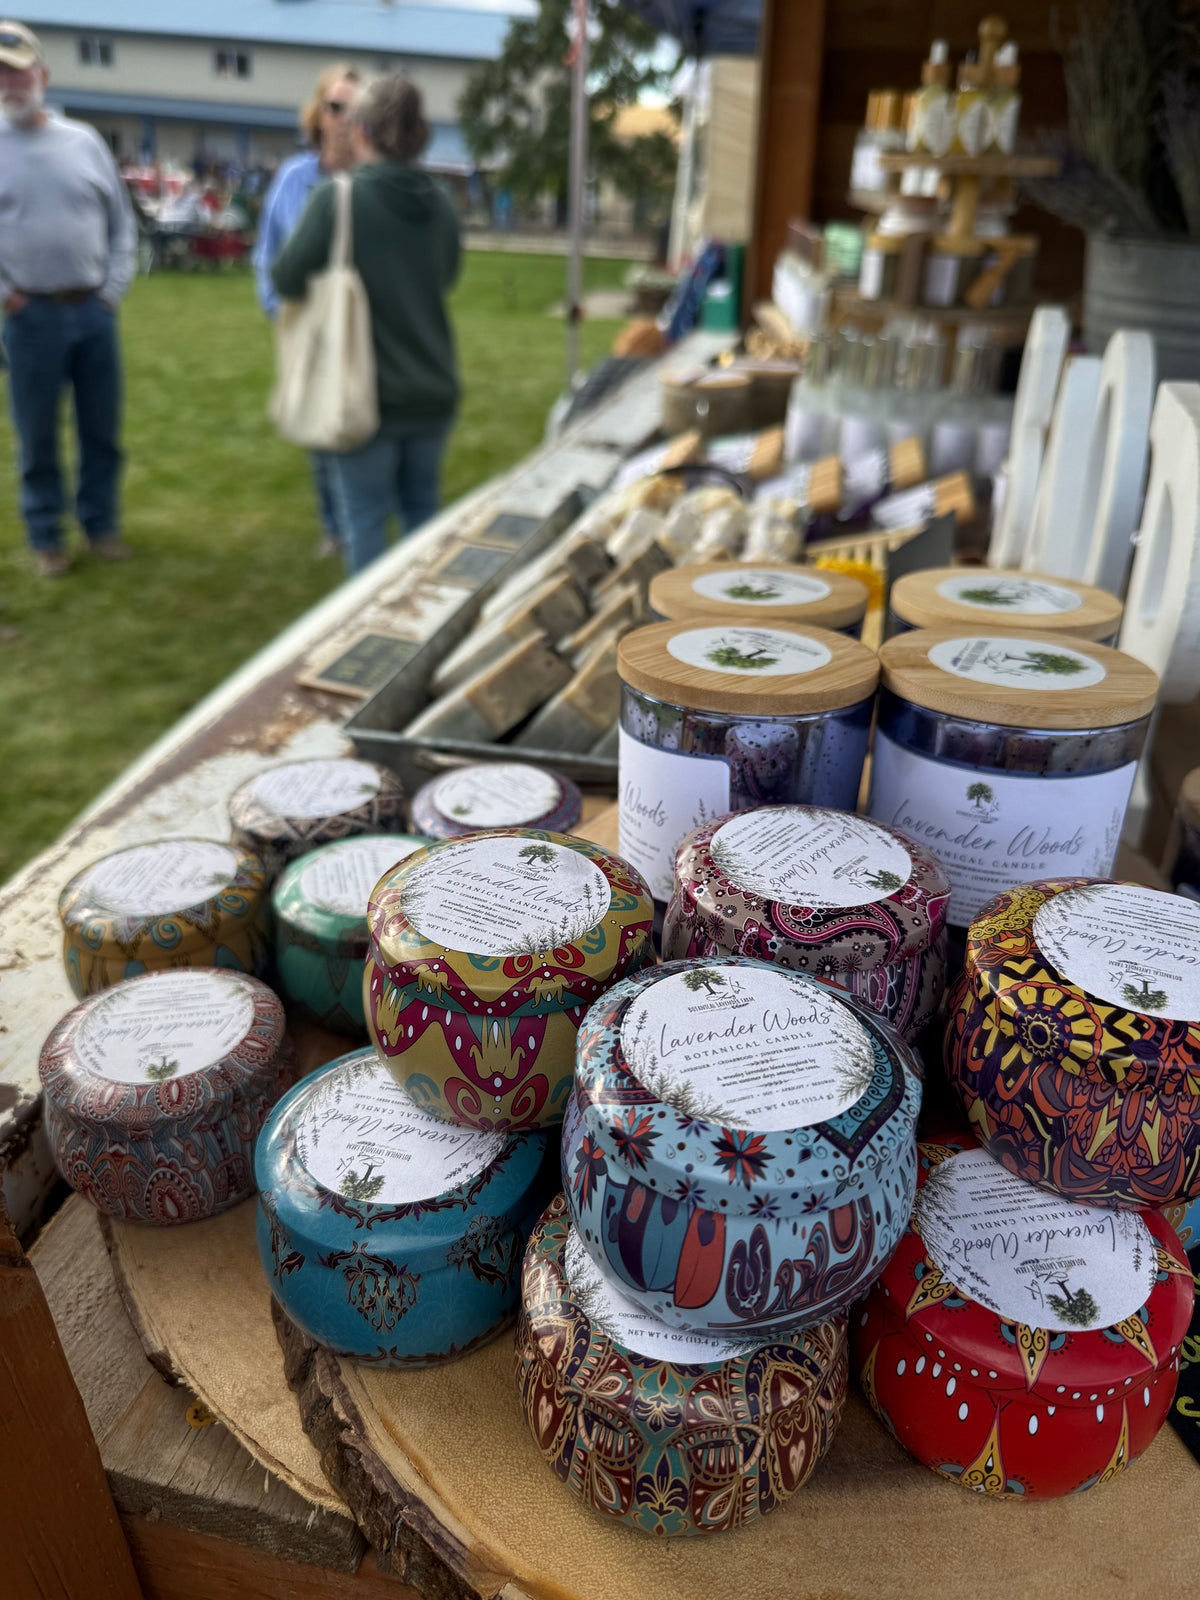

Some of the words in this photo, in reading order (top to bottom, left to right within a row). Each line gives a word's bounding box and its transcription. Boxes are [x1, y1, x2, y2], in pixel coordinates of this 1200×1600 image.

[624, 780, 668, 827] Woods
[890, 800, 997, 851] Lavender
[1007, 825, 1086, 857] Woods
[810, 826, 868, 862] Lavender
[929, 846, 985, 866] TANICAL
[992, 860, 1048, 870] CANDLE
[437, 860, 523, 892] Lavender
[522, 885, 584, 912] Woods
[770, 860, 817, 889] Woods
[446, 880, 505, 900] BOTANICAL
[510, 898, 550, 913] CANDLE
[1054, 926, 1126, 954] Woods
[1086, 923, 1134, 936] CANDLE
[1142, 934, 1200, 952] TANICAL
[660, 1016, 757, 1058] Lavender
[763, 1006, 832, 1032] Woods
[684, 1040, 760, 1061] BOTANICAL
[766, 1031, 814, 1045] CANDLE
[320, 1108, 382, 1136] Woods
[354, 1104, 394, 1114] CANDLE
[746, 1106, 762, 1115] NET
[383, 1122, 474, 1160] Lavender
[970, 1218, 1016, 1230] CANDLE
[1021, 1209, 1090, 1223] BOTANICAL
[950, 1232, 1018, 1262] Woods
[1024, 1216, 1116, 1252] Lavender
[1032, 1262, 1057, 1272] LAVENDER
[1057, 1258, 1086, 1268] BOTANICAL
[618, 1312, 646, 1320] COCONUT
[628, 1328, 644, 1336] NET
[686, 1336, 708, 1345] (113.4
[711, 1340, 719, 1348] g)
